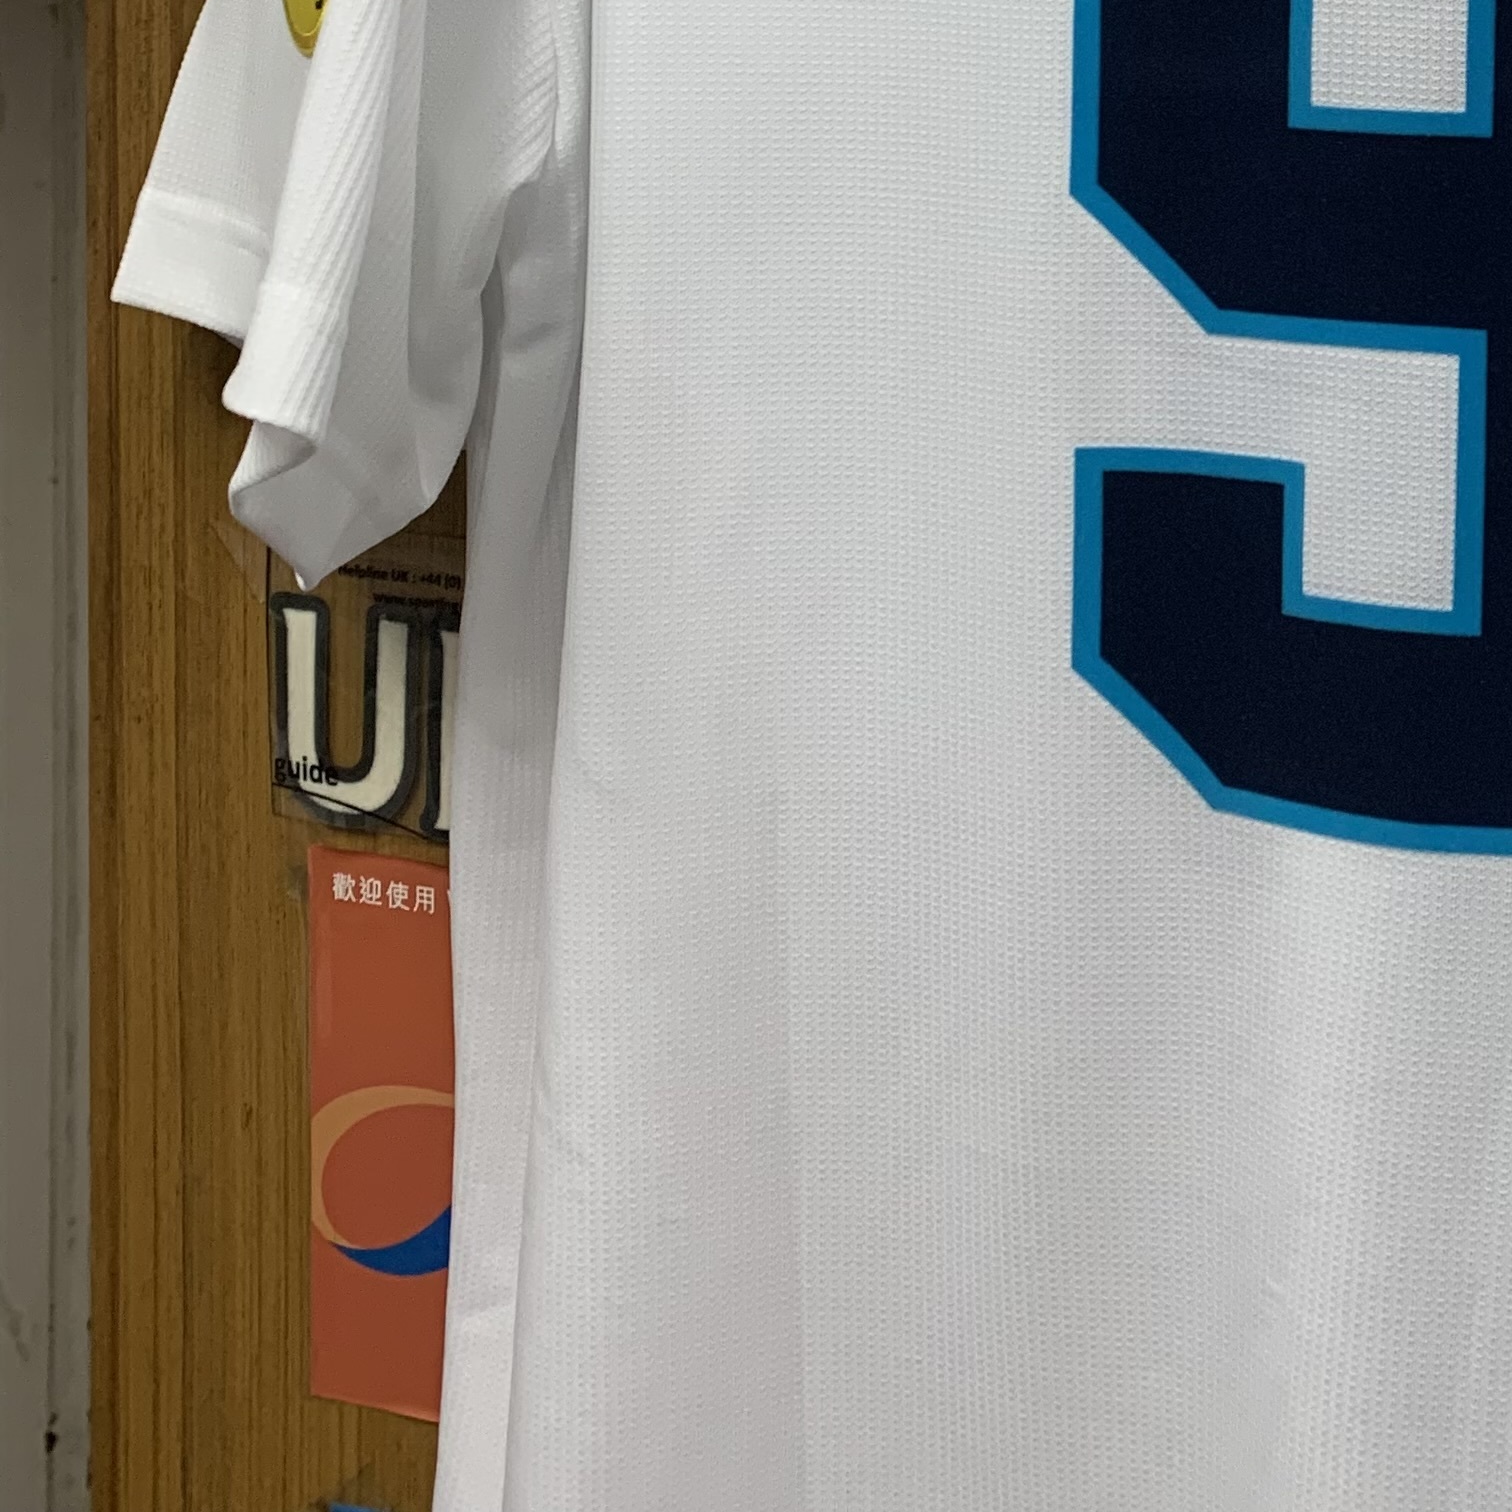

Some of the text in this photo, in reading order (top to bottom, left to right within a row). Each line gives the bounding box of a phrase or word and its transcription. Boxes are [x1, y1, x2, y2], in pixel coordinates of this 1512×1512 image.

[274, 756, 339, 786] guide
[332, 872, 435, 915] 歡迎使用
